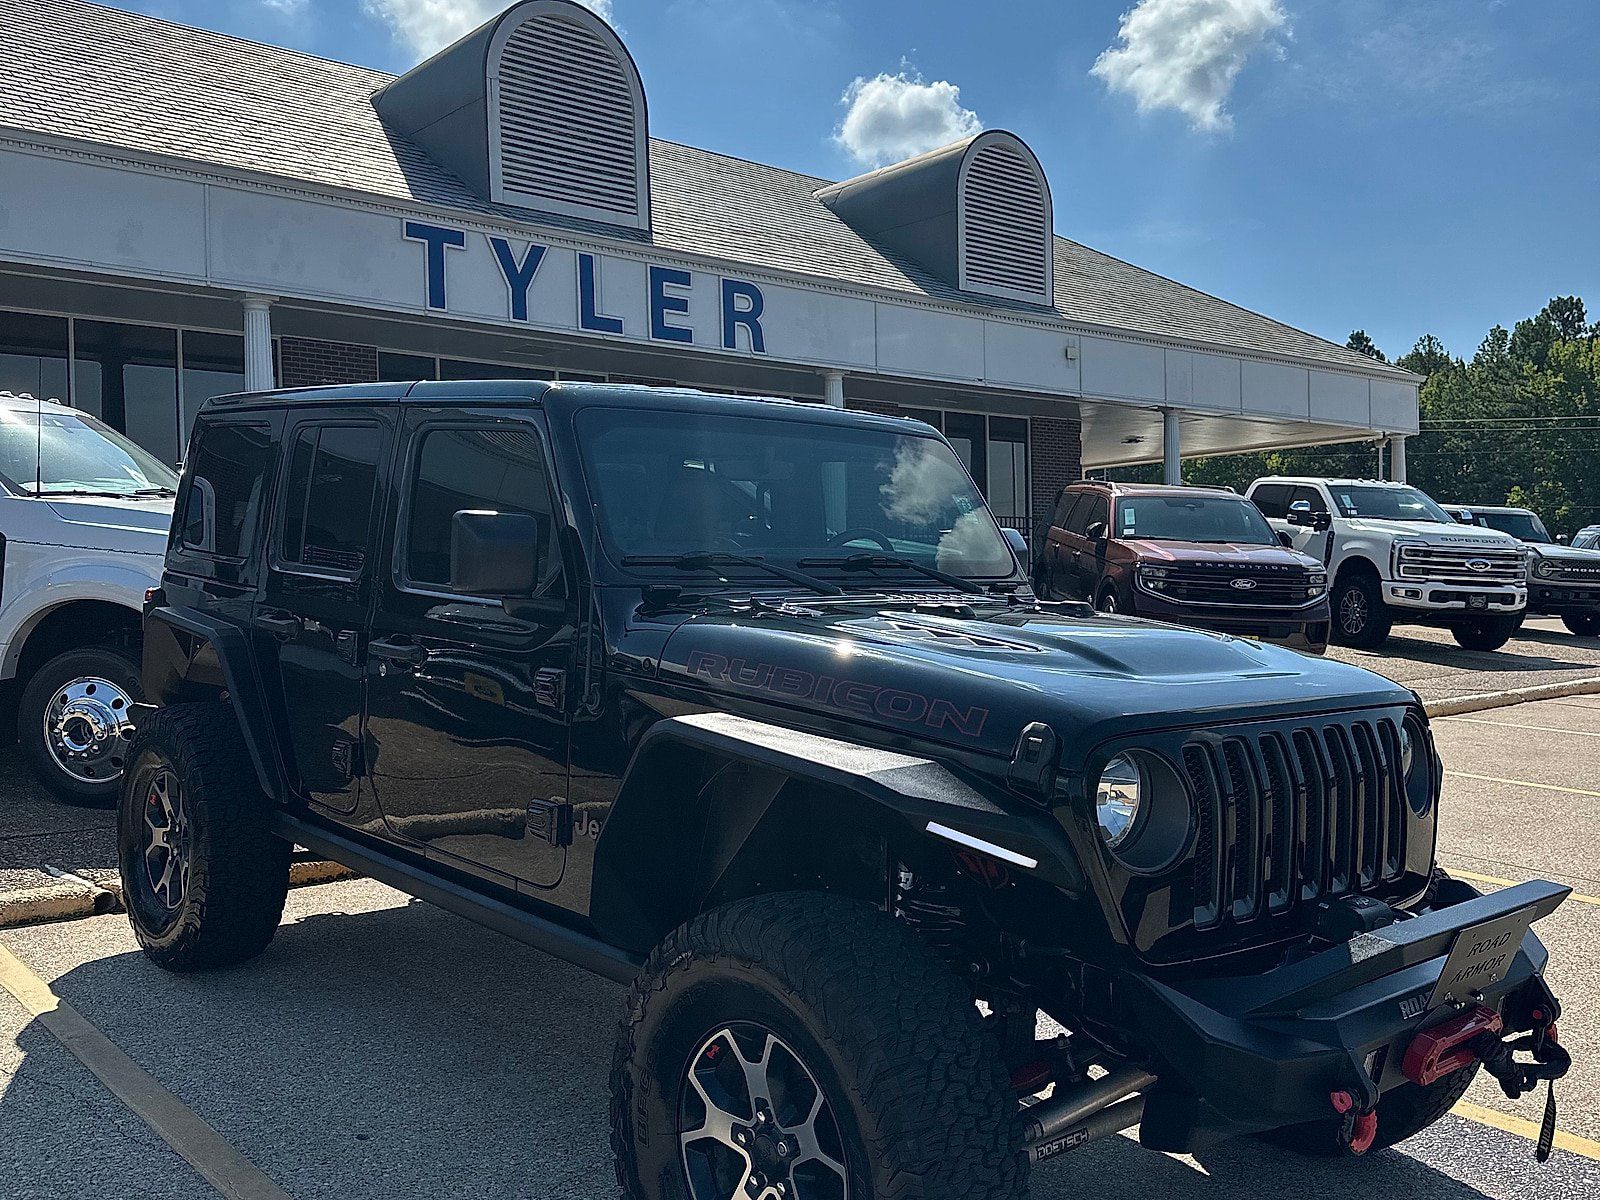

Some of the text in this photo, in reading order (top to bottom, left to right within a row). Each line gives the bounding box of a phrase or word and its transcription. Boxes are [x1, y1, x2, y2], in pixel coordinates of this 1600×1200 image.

[402, 218, 767, 355] TYLER
[1195, 562, 1289, 572] EXPEDITION
[685, 650, 989, 737] RUBICON
[575, 810, 602, 840] Je
[1466, 931, 1512, 958] ROAD
[1450, 953, 1507, 985] ARMOR
[1037, 1129, 1089, 1159] DOETSCH
